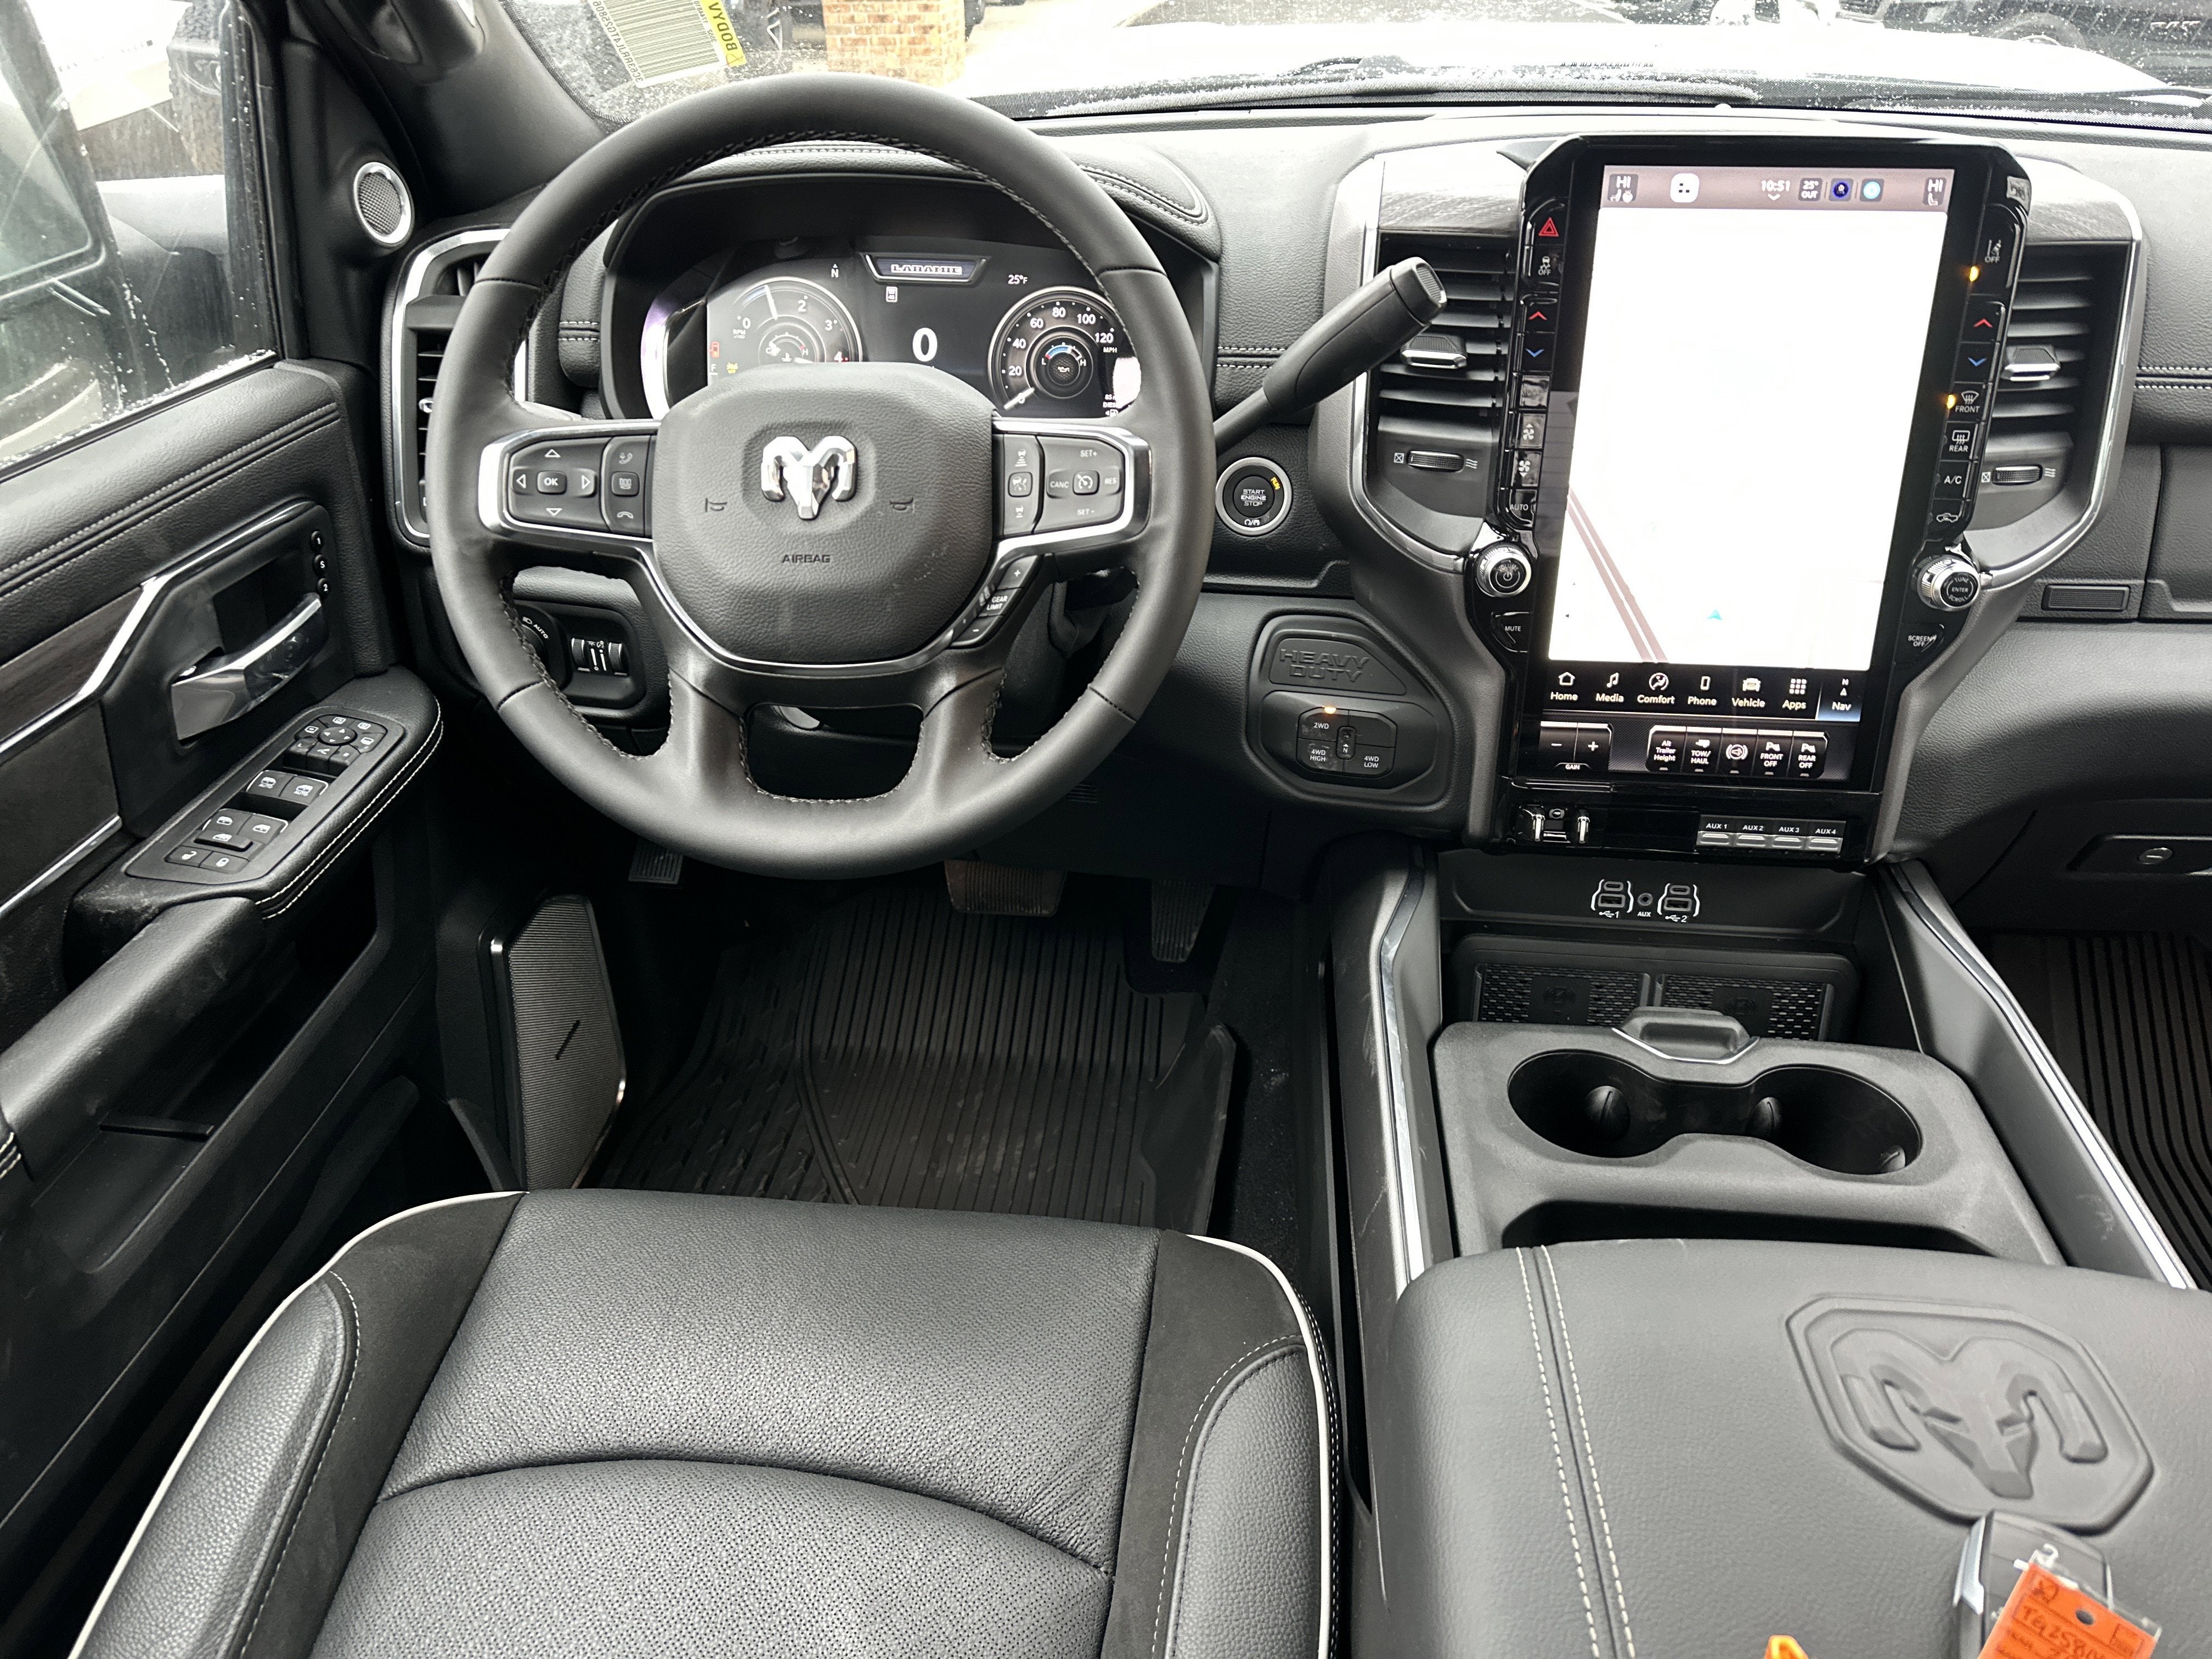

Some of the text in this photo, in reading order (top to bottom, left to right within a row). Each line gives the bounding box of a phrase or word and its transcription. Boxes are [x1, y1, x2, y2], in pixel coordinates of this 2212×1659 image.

[1616, 176, 1631, 188] HI
[1761, 180, 1790, 192] 10:51
[1928, 179, 1943, 192] HI
[1801, 190, 1818, 199] OUT
[831, 268, 839, 278] N
[798, 300, 806, 312] 2
[1052, 308, 1066, 318] 80
[742, 317, 751, 329] 0
[1030, 318, 1043, 328] 60
[1077, 314, 1096, 325] 100
[825, 319, 833, 331] 3
[1094, 332, 1114, 343] 120
[912, 328, 938, 362] 0
[1013, 338, 1026, 349] 40
[834, 351, 843, 363] 4
[1009, 366, 1022, 375] 20
[1955, 405, 1980, 414] FRONT
[544, 477, 558, 486] OK
[1944, 475, 1962, 484] A/C
[781, 554, 831, 563] AIRBAG
[323, 583, 328, 591] 2
[1948, 594, 1968, 602] SCROLL
[533, 624, 549, 639] AUTO
[1279, 648, 1370, 669] HEAVY
[1289, 664, 1363, 682] DUTY
[1550, 691, 1578, 701] Home
[1595, 693, 1624, 703] Media
[1637, 695, 1675, 704] Comfort
[1688, 696, 1717, 706] Phone
[1731, 697, 1765, 708] Vehicle
[1782, 699, 1807, 710] Apps
[1832, 701, 1852, 711] Nav
